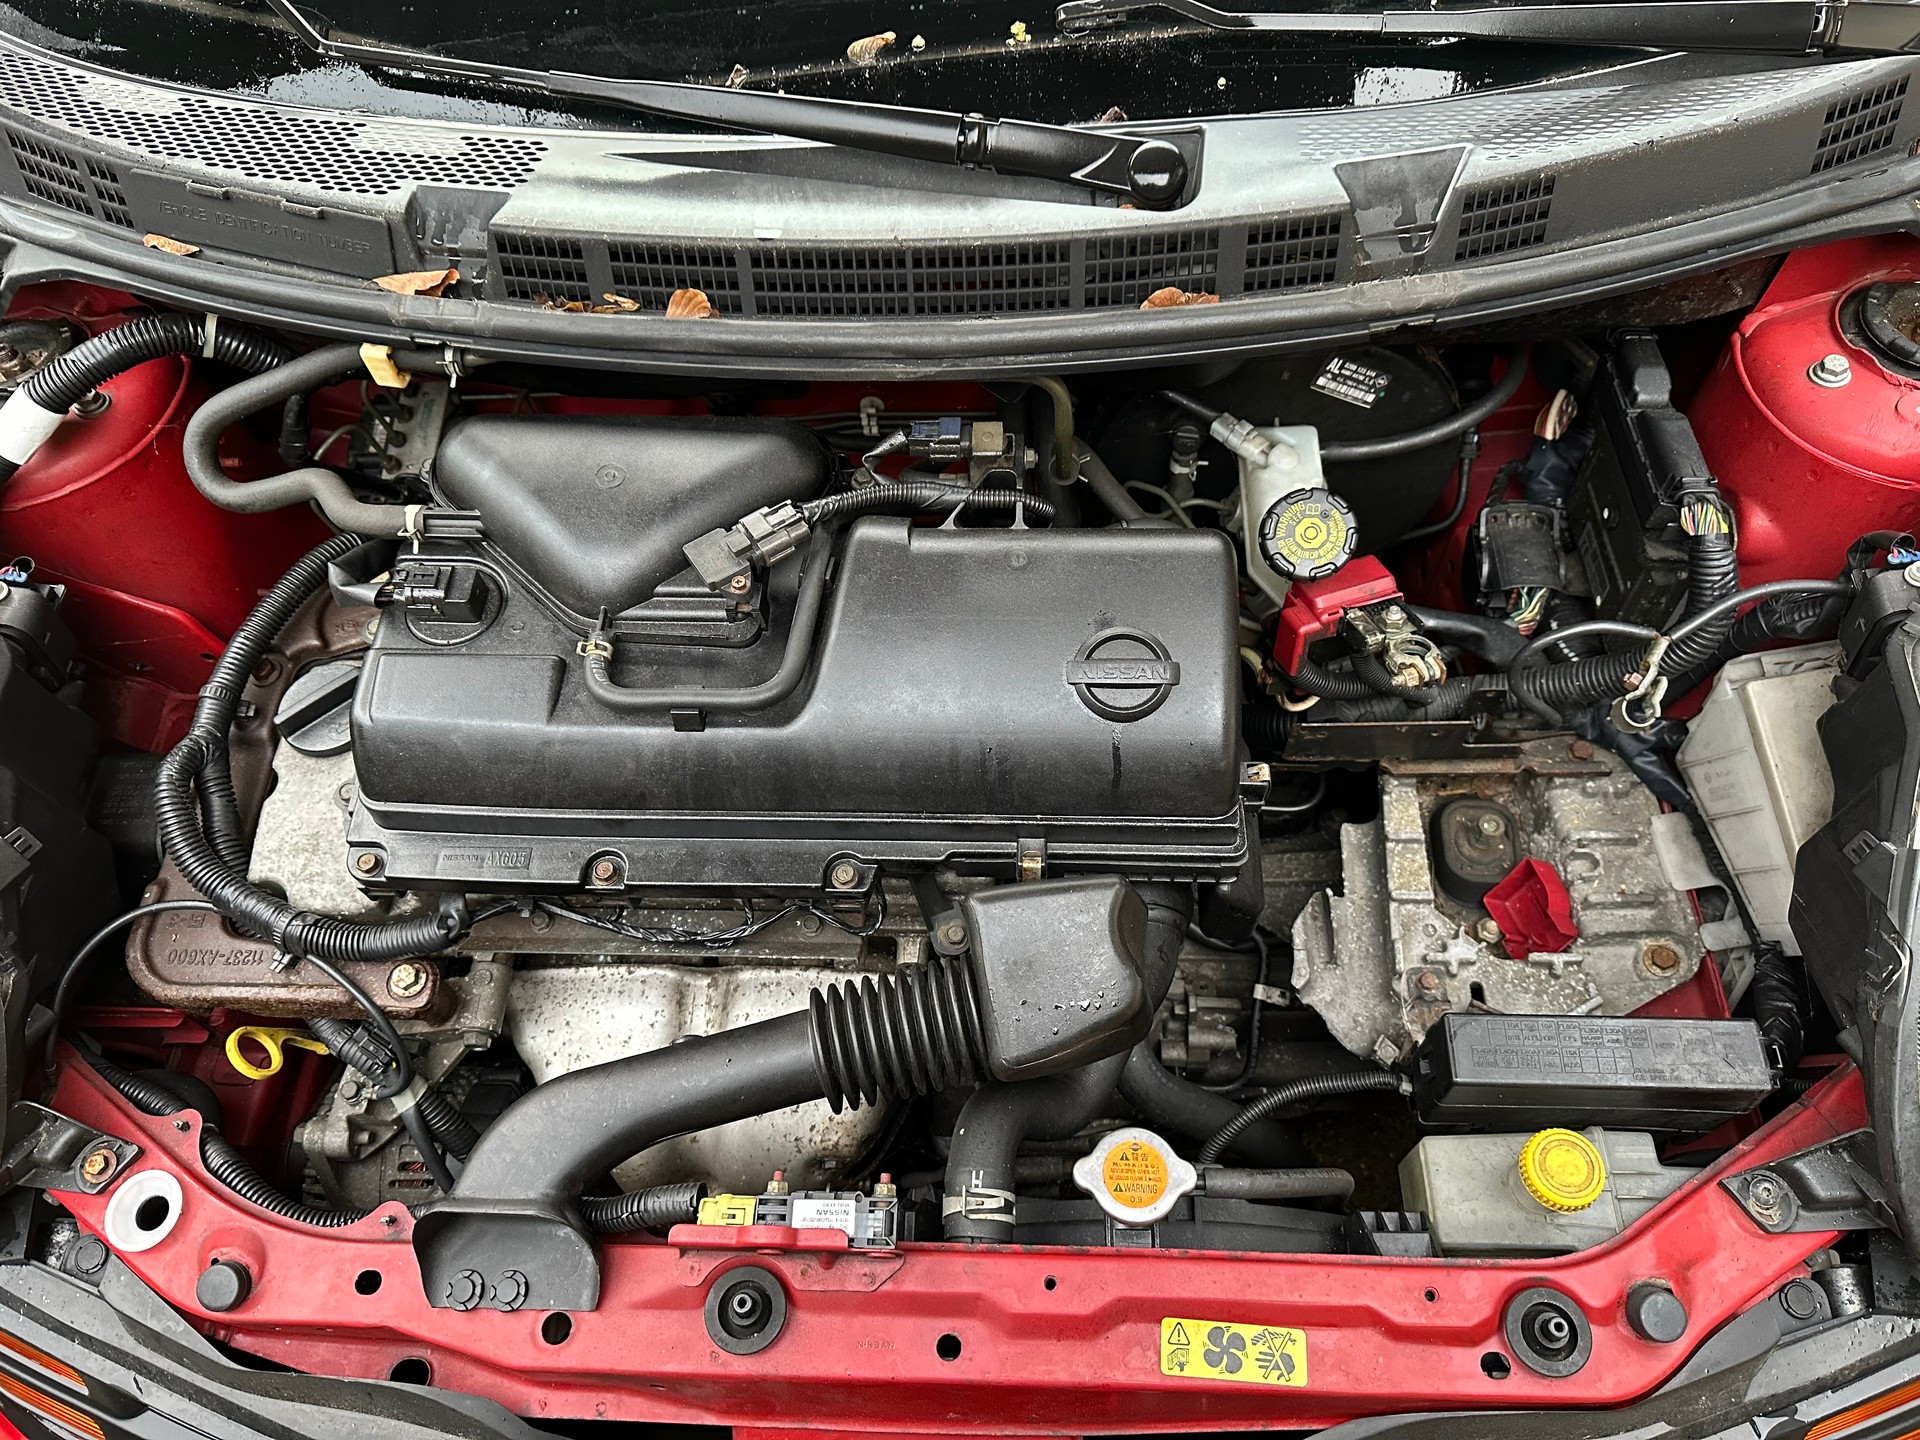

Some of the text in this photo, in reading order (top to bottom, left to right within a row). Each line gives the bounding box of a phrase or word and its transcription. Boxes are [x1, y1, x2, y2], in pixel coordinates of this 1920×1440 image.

[214, 211, 312, 243] IDENTIFICATION
[319, 233, 371, 256] NUMBER
[1326, 357, 1343, 374] AL
[1276, 501, 1305, 538] WARNING
[1289, 512, 1303, 526] SEE
[1079, 664, 1169, 680] NISSAN
[442, 850, 527, 867] NISSAN AX605
[1124, 1183, 1158, 1194] WARNING
[1130, 1196, 1143, 1204] 0.9
